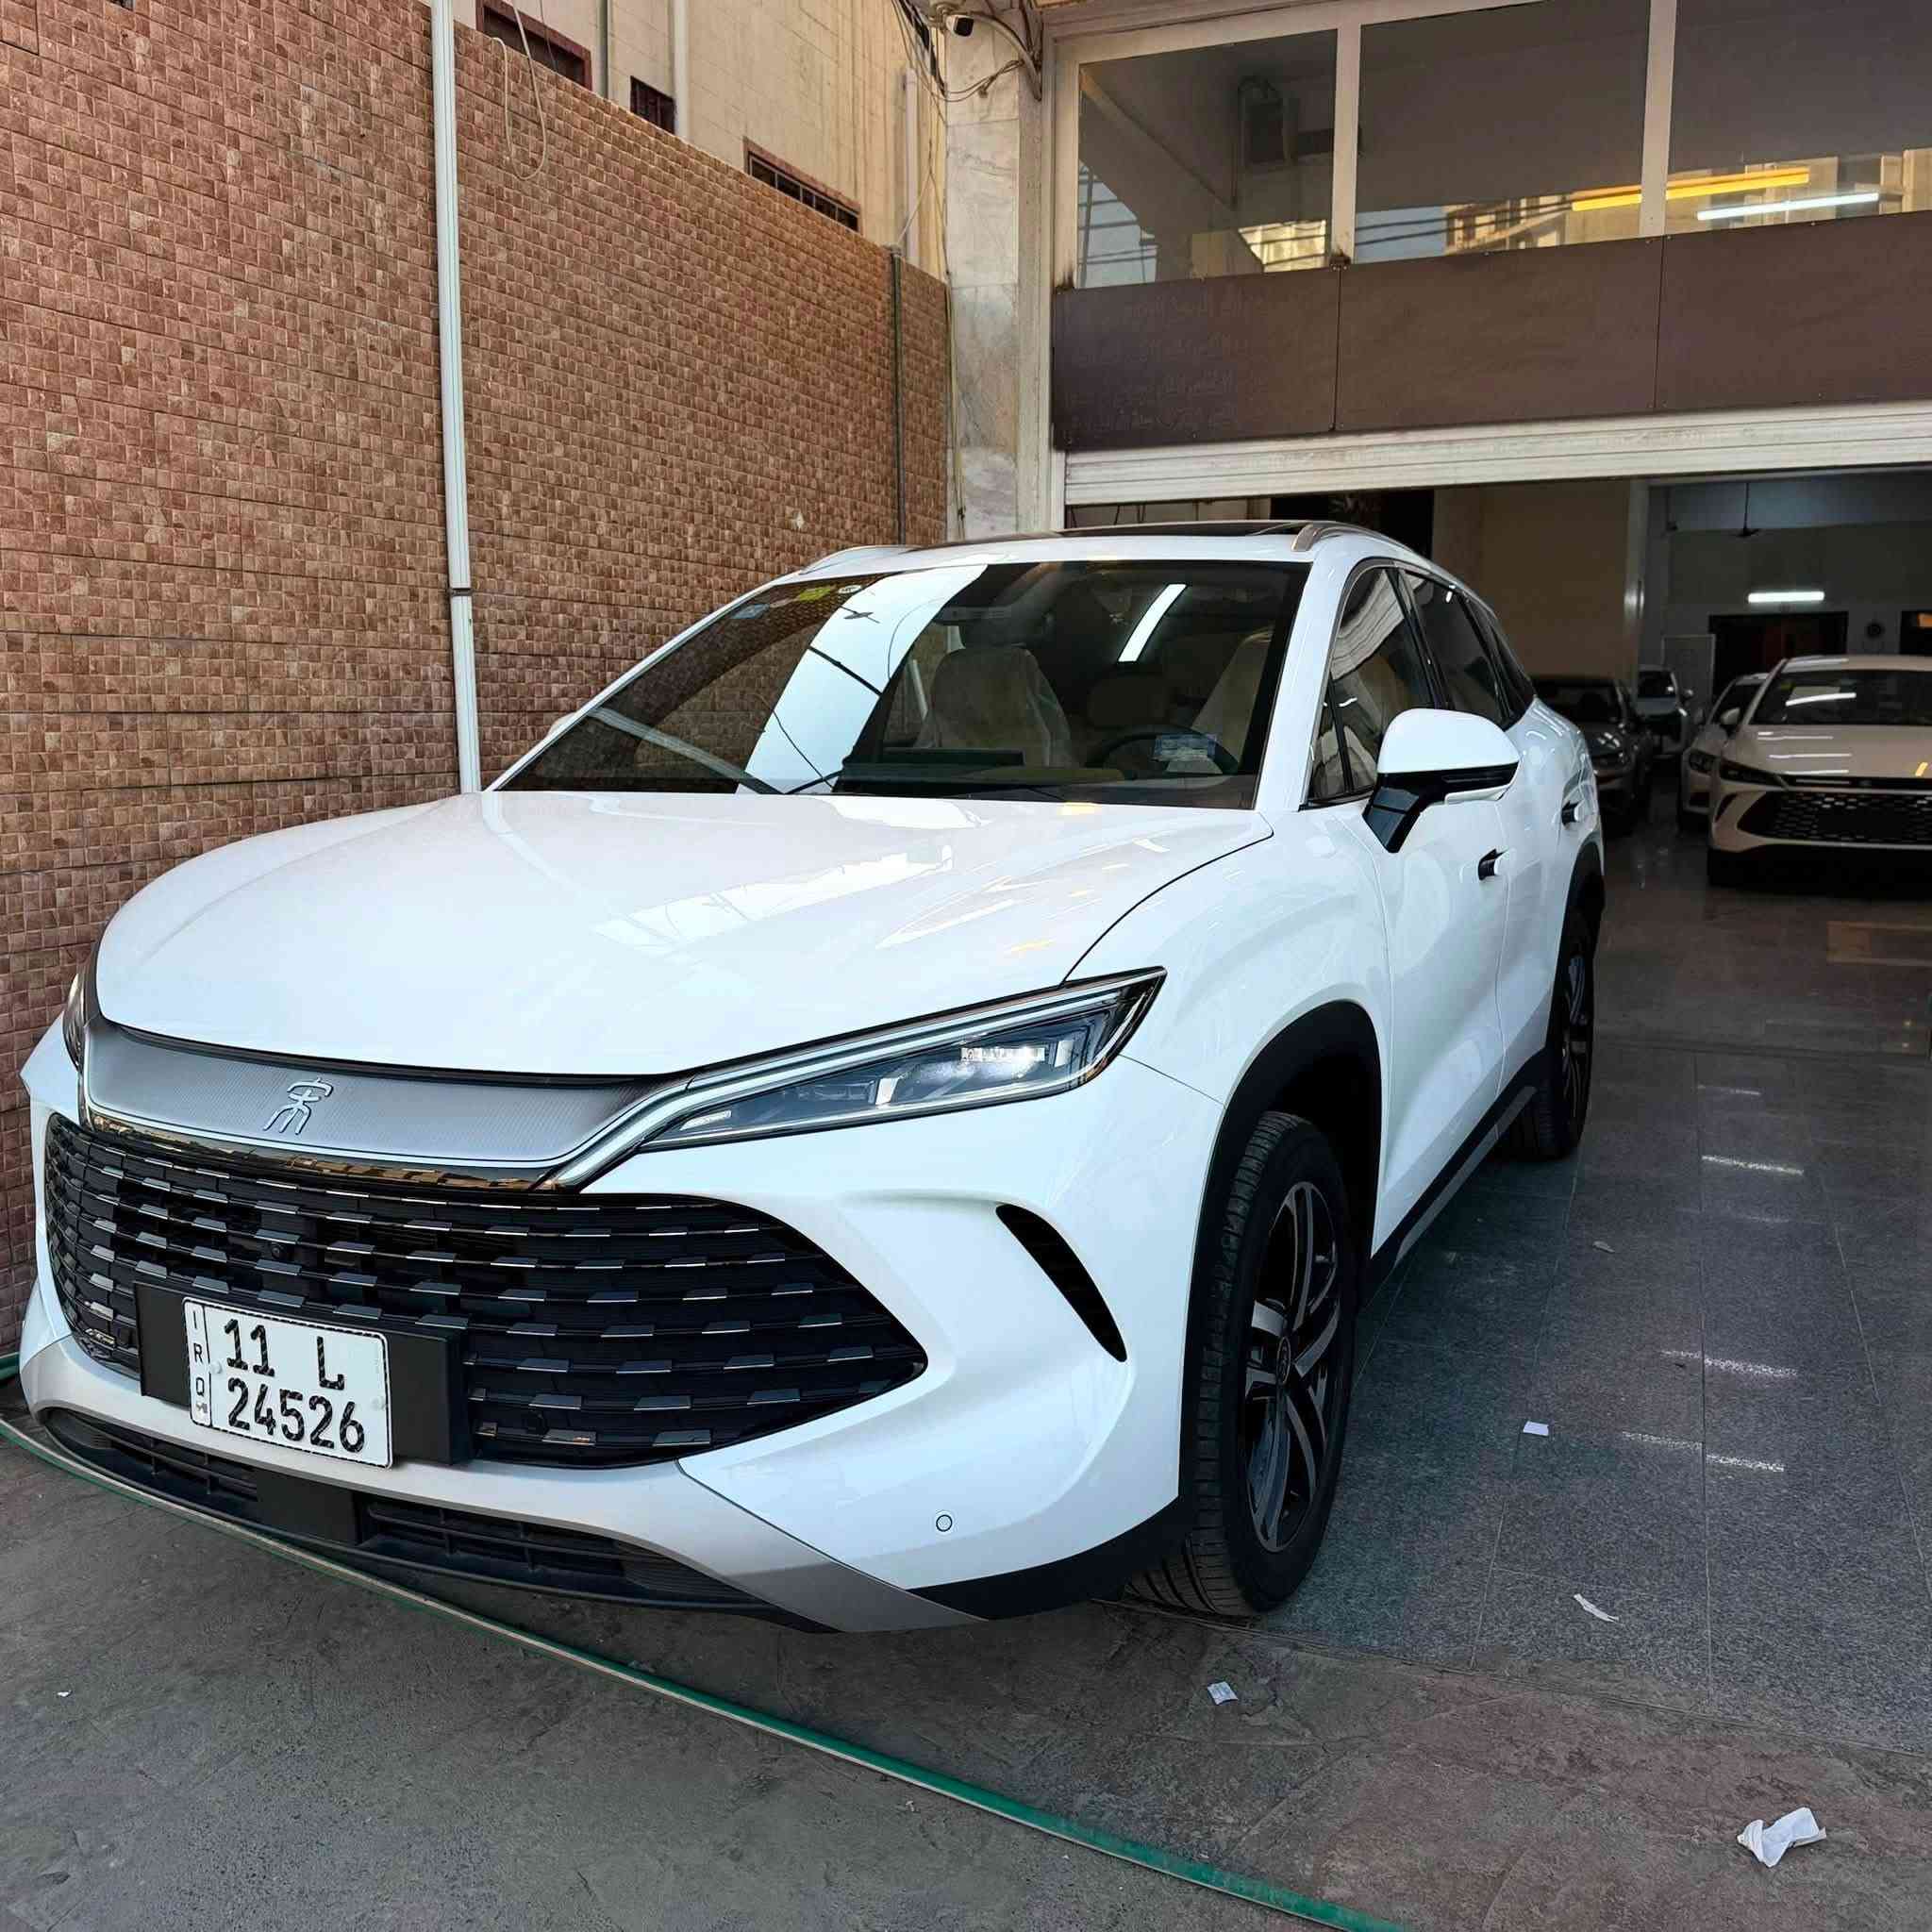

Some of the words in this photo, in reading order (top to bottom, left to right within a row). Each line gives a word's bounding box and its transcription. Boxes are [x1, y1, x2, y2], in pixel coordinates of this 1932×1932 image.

[192, 1309, 206, 1397] IRQ
[224, 1318, 275, 1377] 11
[316, 1336, 345, 1391] L
[227, 1377, 365, 1454] 24526
